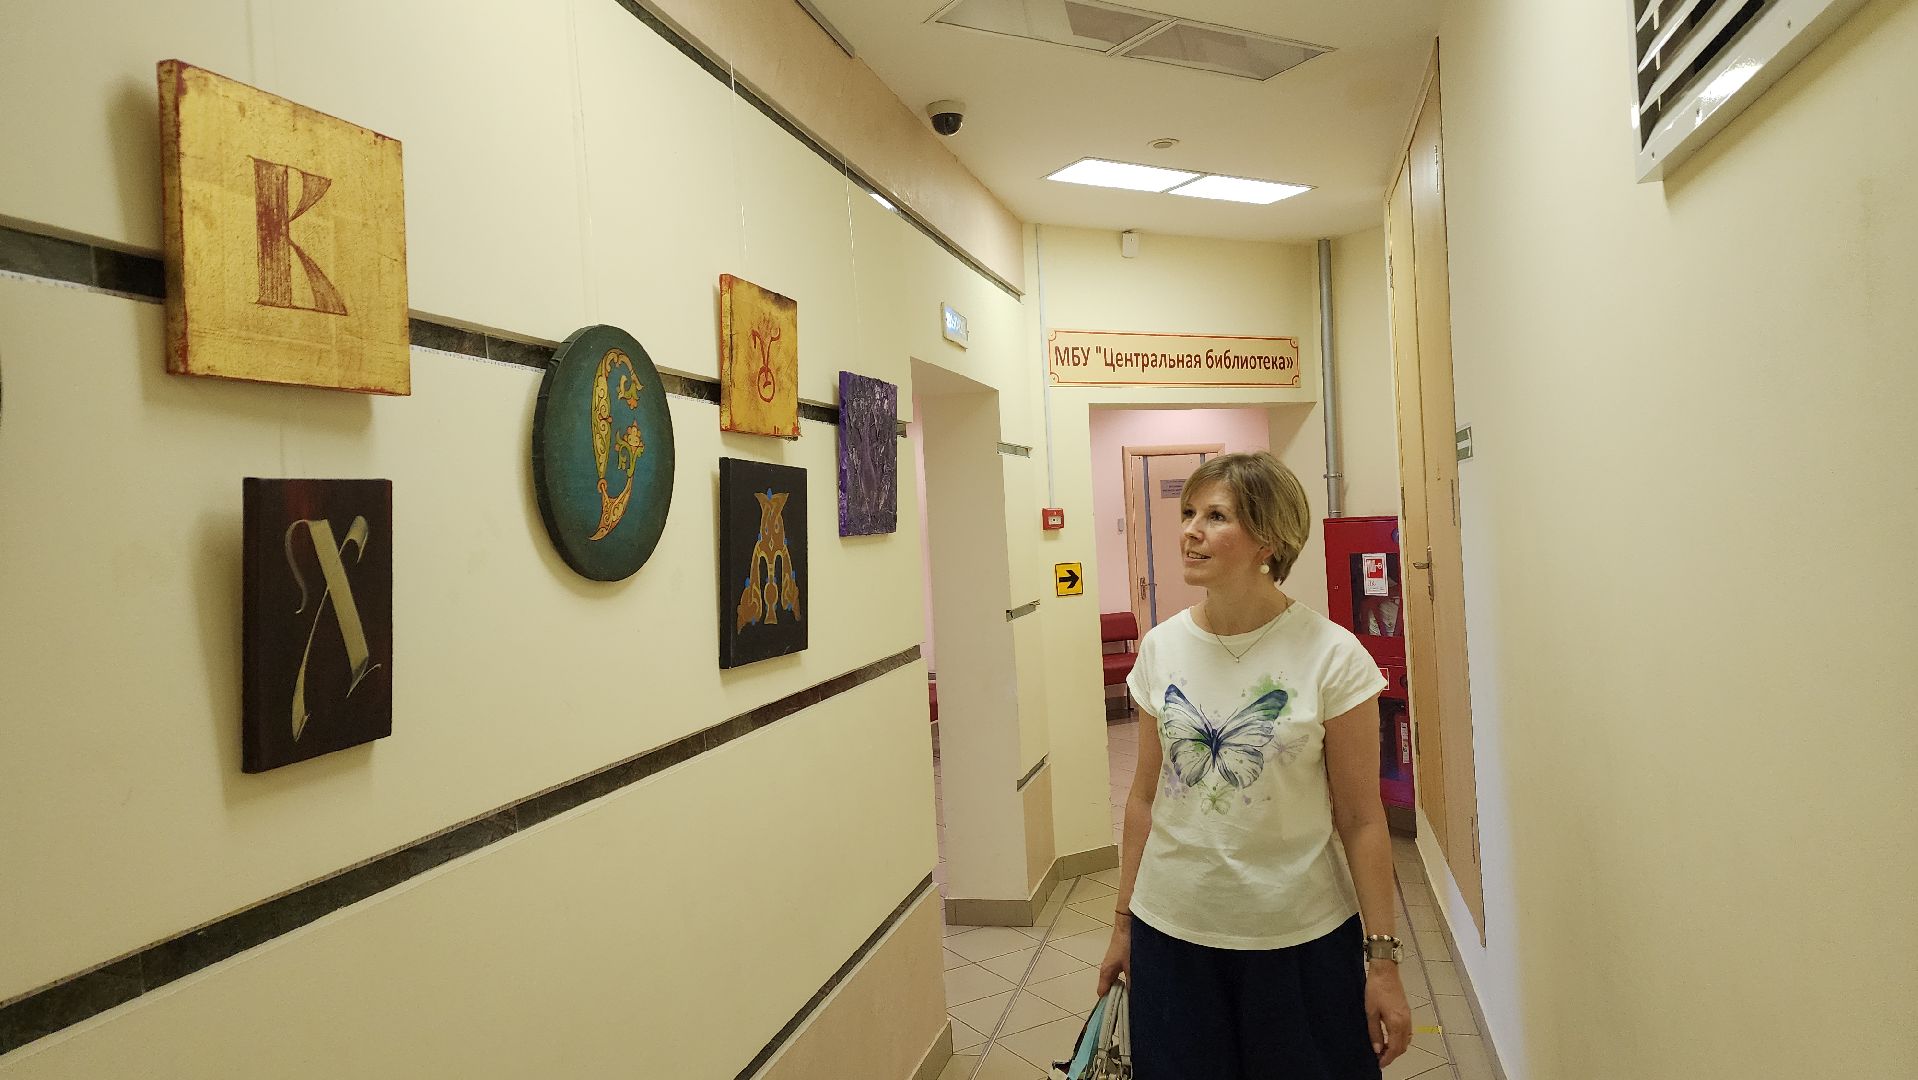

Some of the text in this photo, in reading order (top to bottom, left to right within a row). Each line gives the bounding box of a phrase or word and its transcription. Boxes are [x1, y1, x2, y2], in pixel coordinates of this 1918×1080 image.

[1054, 345, 1294, 373] МБУ "Центральная библиотека»
